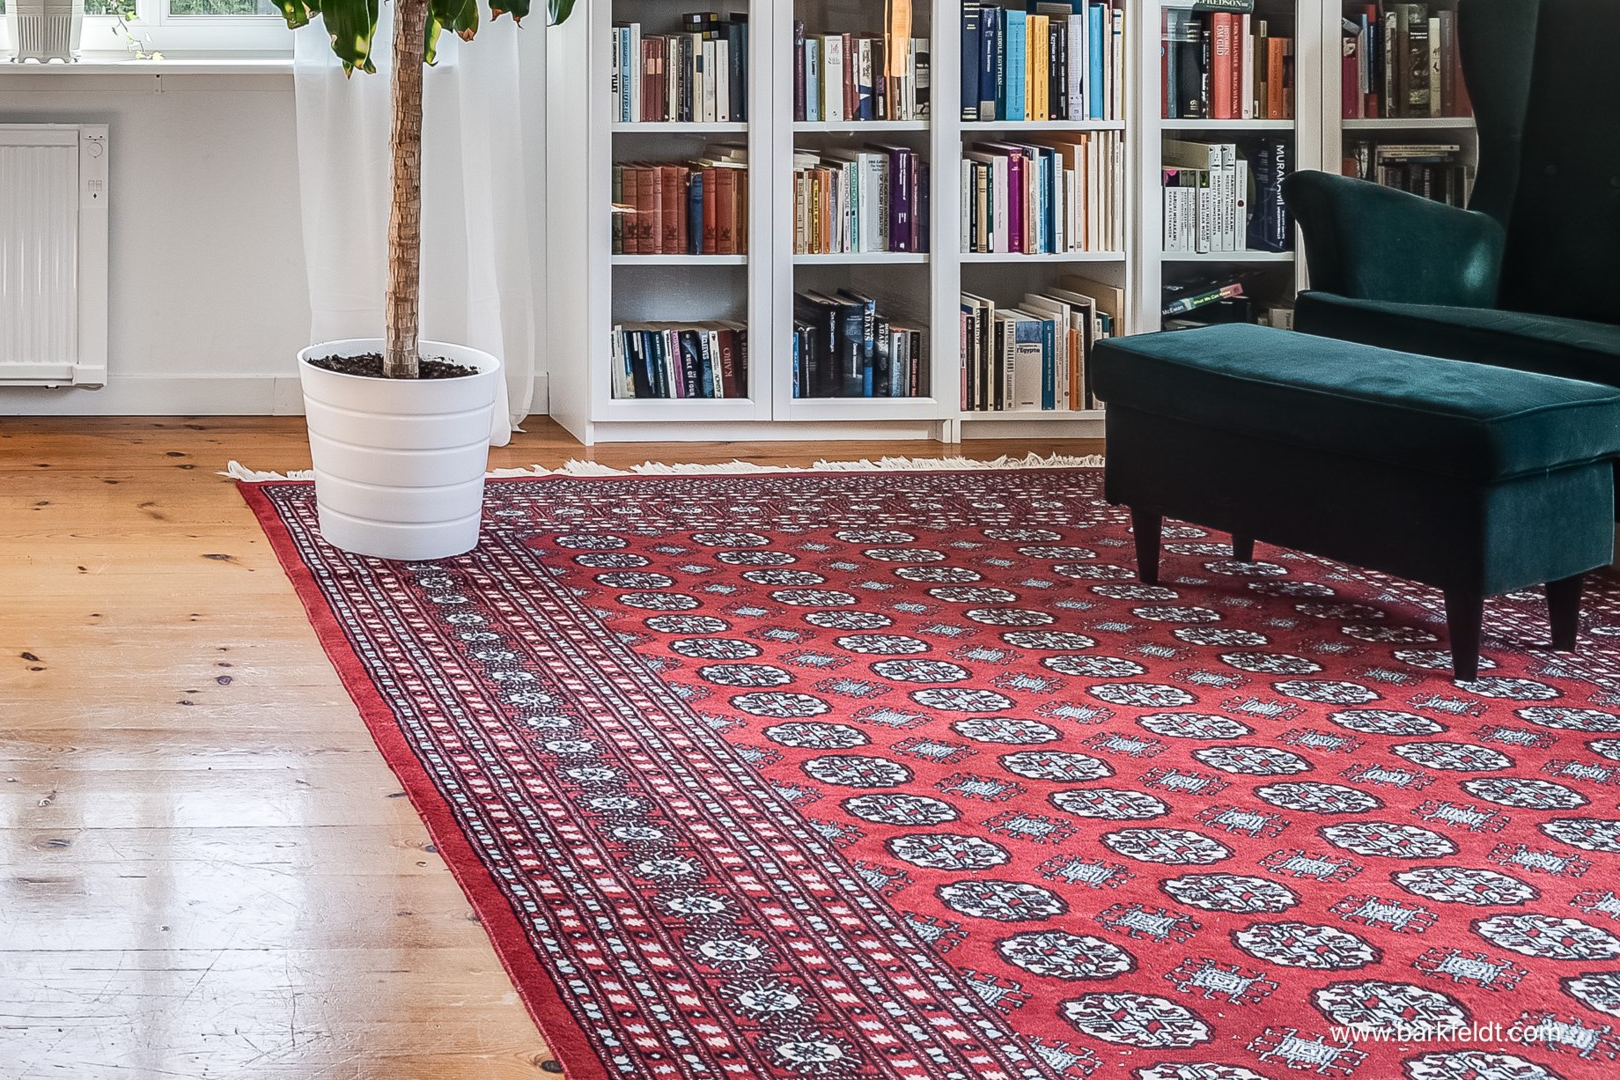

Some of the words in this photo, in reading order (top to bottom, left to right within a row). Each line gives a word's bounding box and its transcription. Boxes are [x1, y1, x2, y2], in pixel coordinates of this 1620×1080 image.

[1216, 24, 1224, 38] OM
[1216, 39, 1224, 56] GUD
[1162, 305, 1184, 315] McEwan
[724, 347, 732, 377] KAIRO
